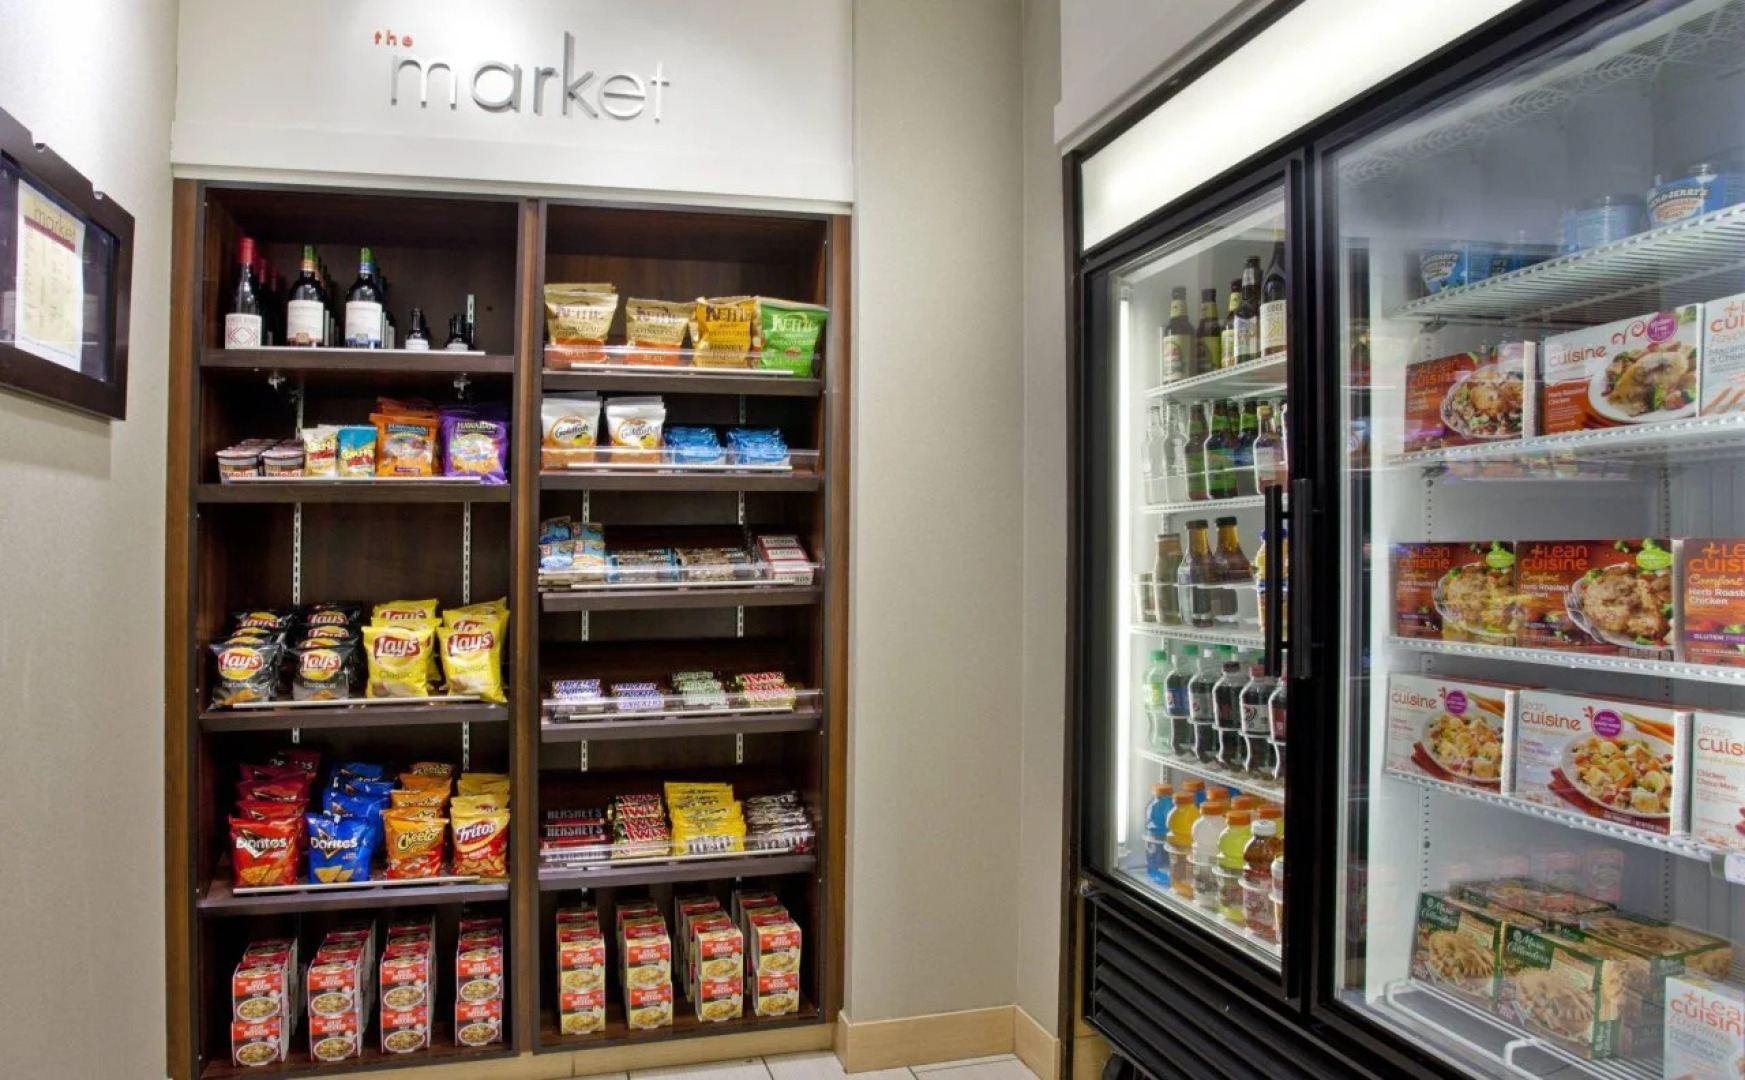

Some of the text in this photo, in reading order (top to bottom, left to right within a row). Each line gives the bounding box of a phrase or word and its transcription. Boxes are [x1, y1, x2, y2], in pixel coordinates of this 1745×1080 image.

[374, 29, 413, 47] the
[390, 31, 670, 124] market
[34, 208, 76, 241] market
[772, 312, 818, 332] KETTLE
[1548, 345, 1607, 367] cuisine
[555, 423, 589, 438] Goldfish
[1545, 545, 1588, 558] Lean
[1521, 558, 1588, 571] cuisine
[1688, 573, 1744, 587] Comfort
[1688, 588, 1712, 596] Herb
[1689, 596, 1728, 606] Chicken
[1693, 633, 1724, 641] GLUTEN
[1392, 691, 1438, 710] cuisine
[1520, 711, 1582, 731] cuisine
[236, 837, 287, 849] Doritos
[310, 838, 358, 849] Doritos
[1701, 995, 1745, 1021] Lea
[1669, 998, 1745, 1037] cuisin
